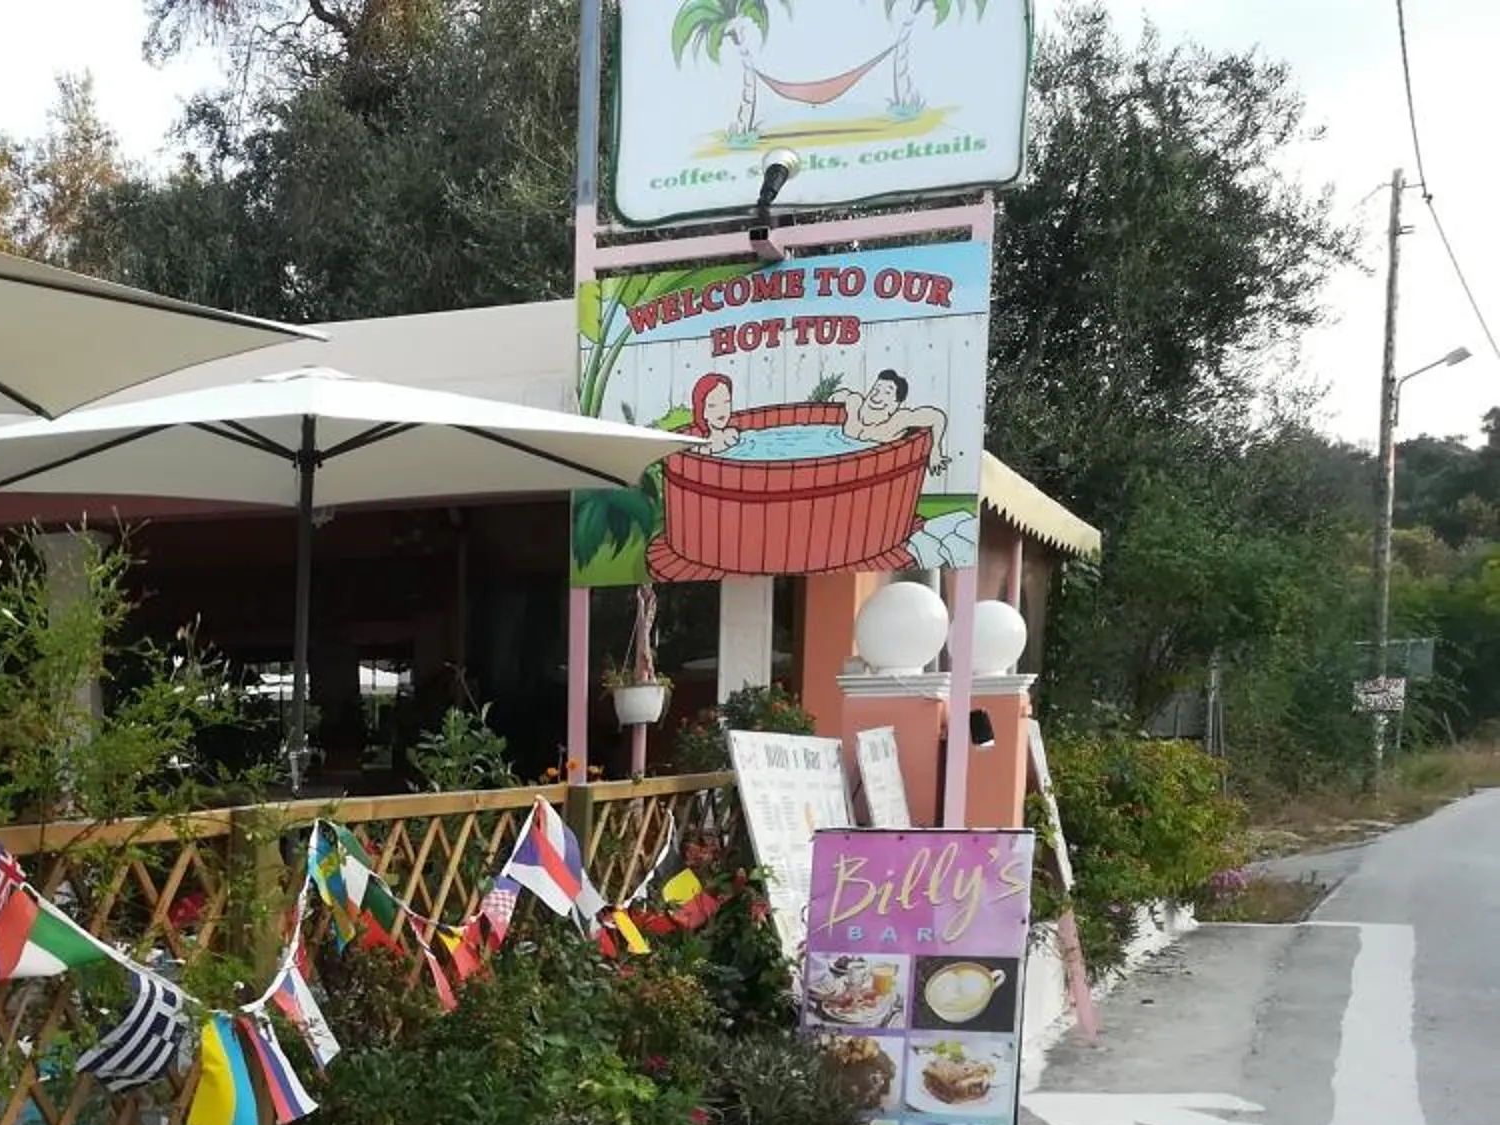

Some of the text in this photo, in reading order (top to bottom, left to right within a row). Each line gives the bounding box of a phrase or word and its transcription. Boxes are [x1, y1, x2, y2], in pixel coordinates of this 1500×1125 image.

[649, 136, 987, 190] coffee, scks, cocktails
[626, 266, 954, 335] WELCOME TO OUR
[709, 315, 861, 358] HOT TUB
[812, 842, 1029, 944] Billy's
[847, 926, 935, 943] BAR
